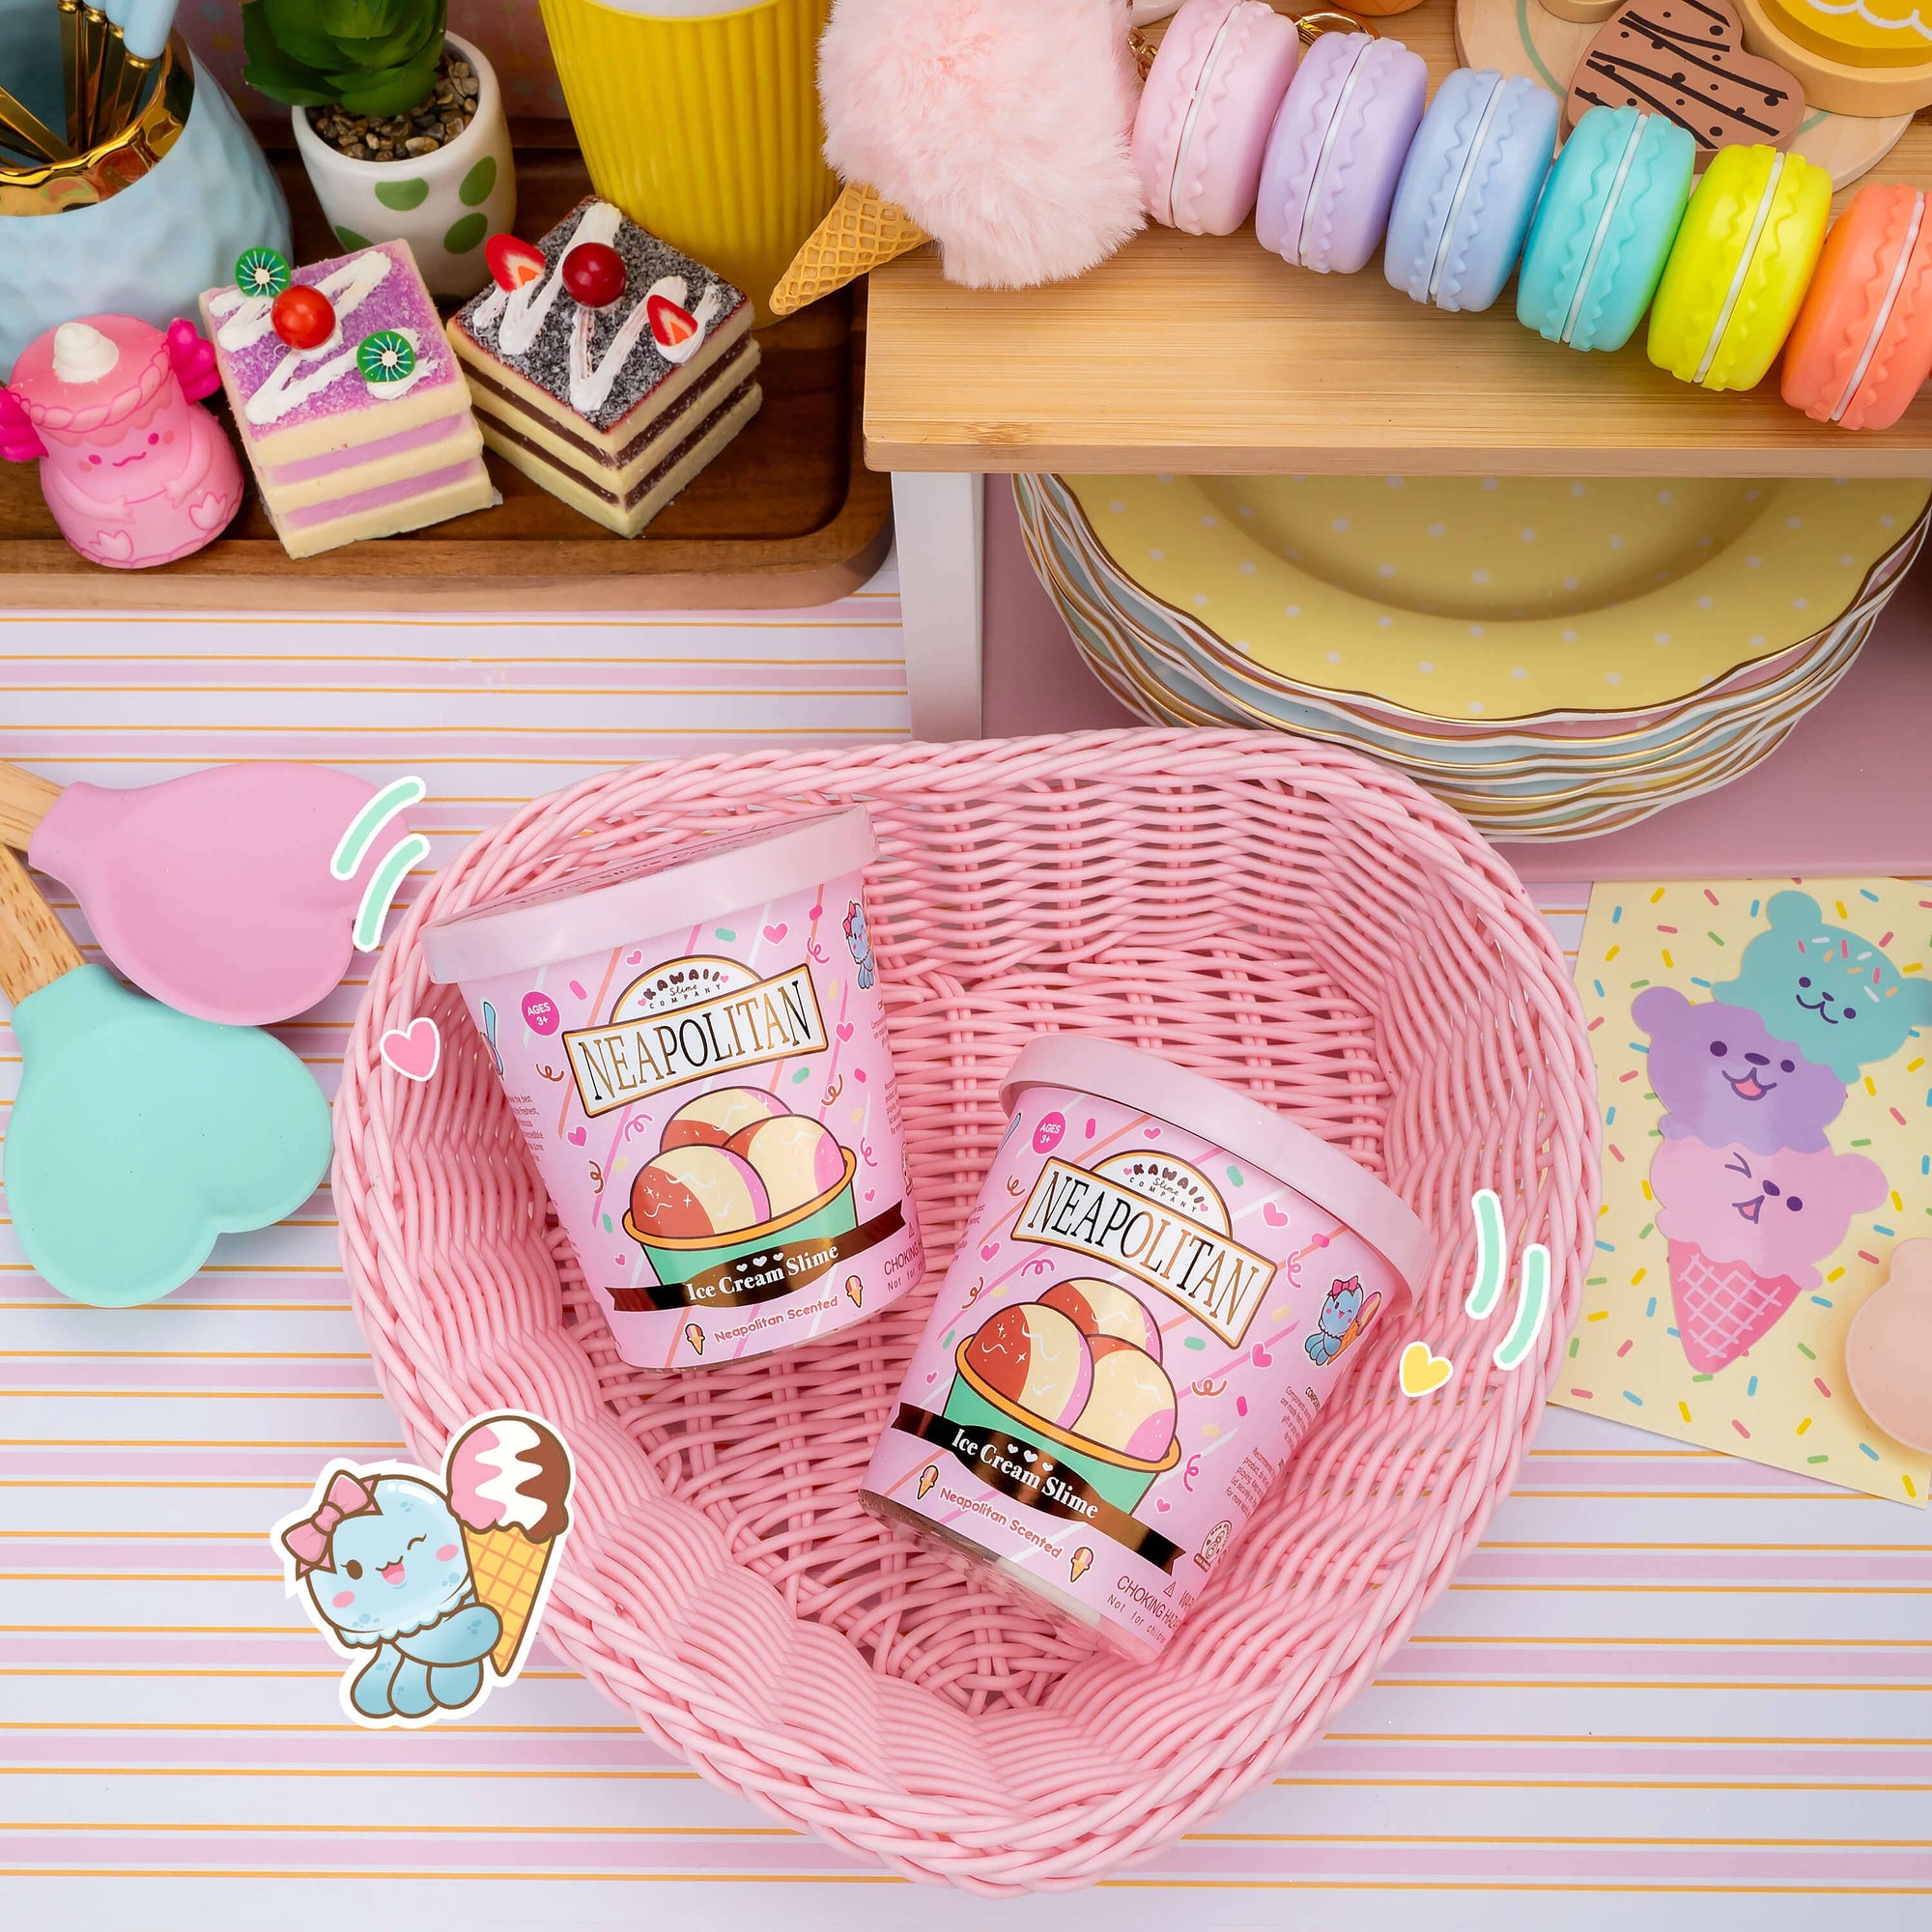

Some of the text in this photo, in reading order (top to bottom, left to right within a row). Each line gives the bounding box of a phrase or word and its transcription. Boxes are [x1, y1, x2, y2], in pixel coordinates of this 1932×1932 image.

[643, 969, 720, 1000] KAWAII
[649, 983, 721, 1009] COMPANY
[669, 984, 698, 997] Slime
[527, 1002, 551, 1015] AGES
[536, 1016, 549, 1026] 3+
[579, 980, 810, 1100] NEAPOLITAN
[1038, 1122, 1062, 1134] AGES
[1040, 1134, 1050, 1144] 3+
[1129, 1177, 1197, 1212] COMPANY
[1133, 1163, 1205, 1204] KAWAII
[1152, 1177, 1179, 1196] Slime
[884, 1241, 919, 1276] CHOKING
[1028, 1171, 1259, 1325] NEAPOLITAN
[686, 1244, 839, 1301] Ice Cream Slime
[888, 1277, 901, 1292] Not
[713, 1295, 838, 1343] Neapolitan Scented
[952, 1428, 1098, 1519] Ice Cream Slime
[940, 1488, 1063, 1558] Neapolitan Scented
[1107, 1594, 1125, 1612] Not
[1131, 1611, 1144, 1626] for
[1117, 1576, 1165, 1618] CHOKING
